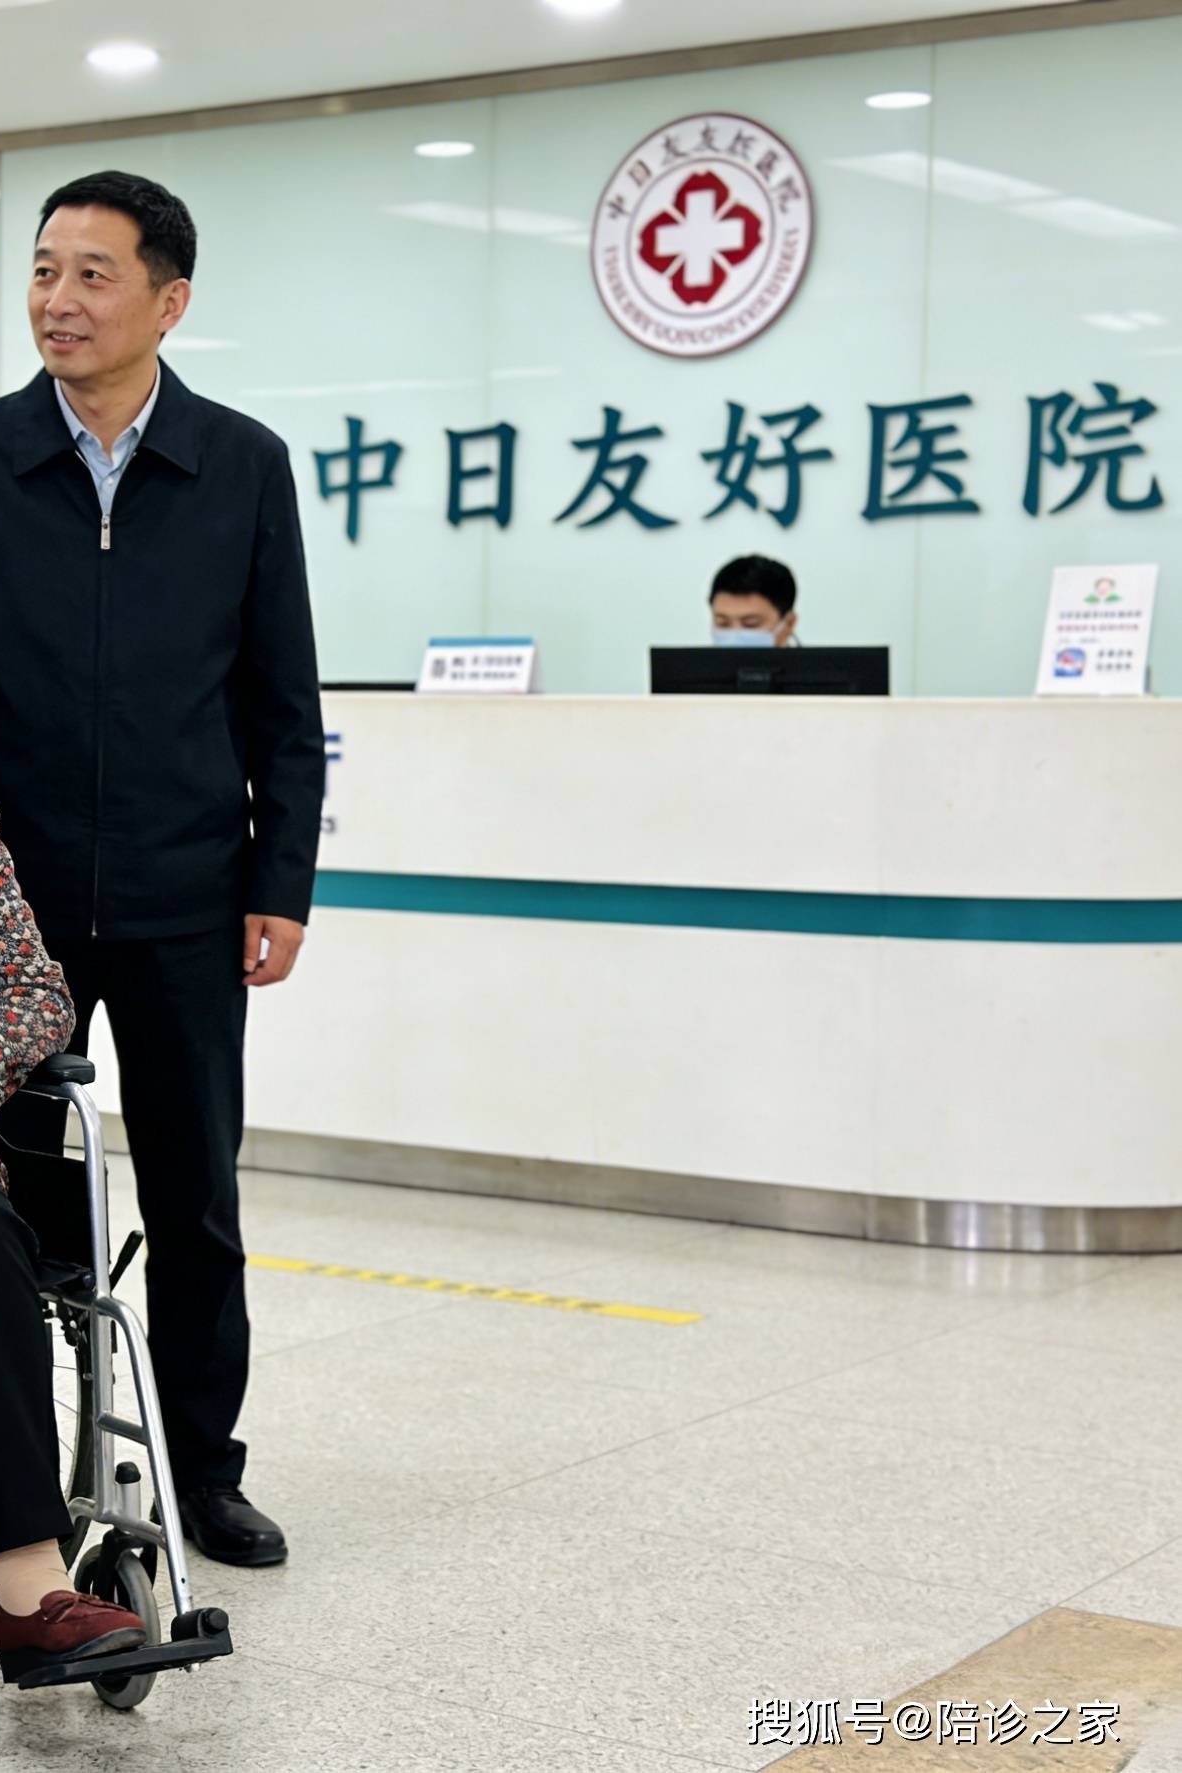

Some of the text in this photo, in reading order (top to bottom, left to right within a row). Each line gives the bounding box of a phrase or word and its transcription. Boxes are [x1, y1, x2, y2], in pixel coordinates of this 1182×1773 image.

[313, 381, 1165, 543] 中日友好医院
